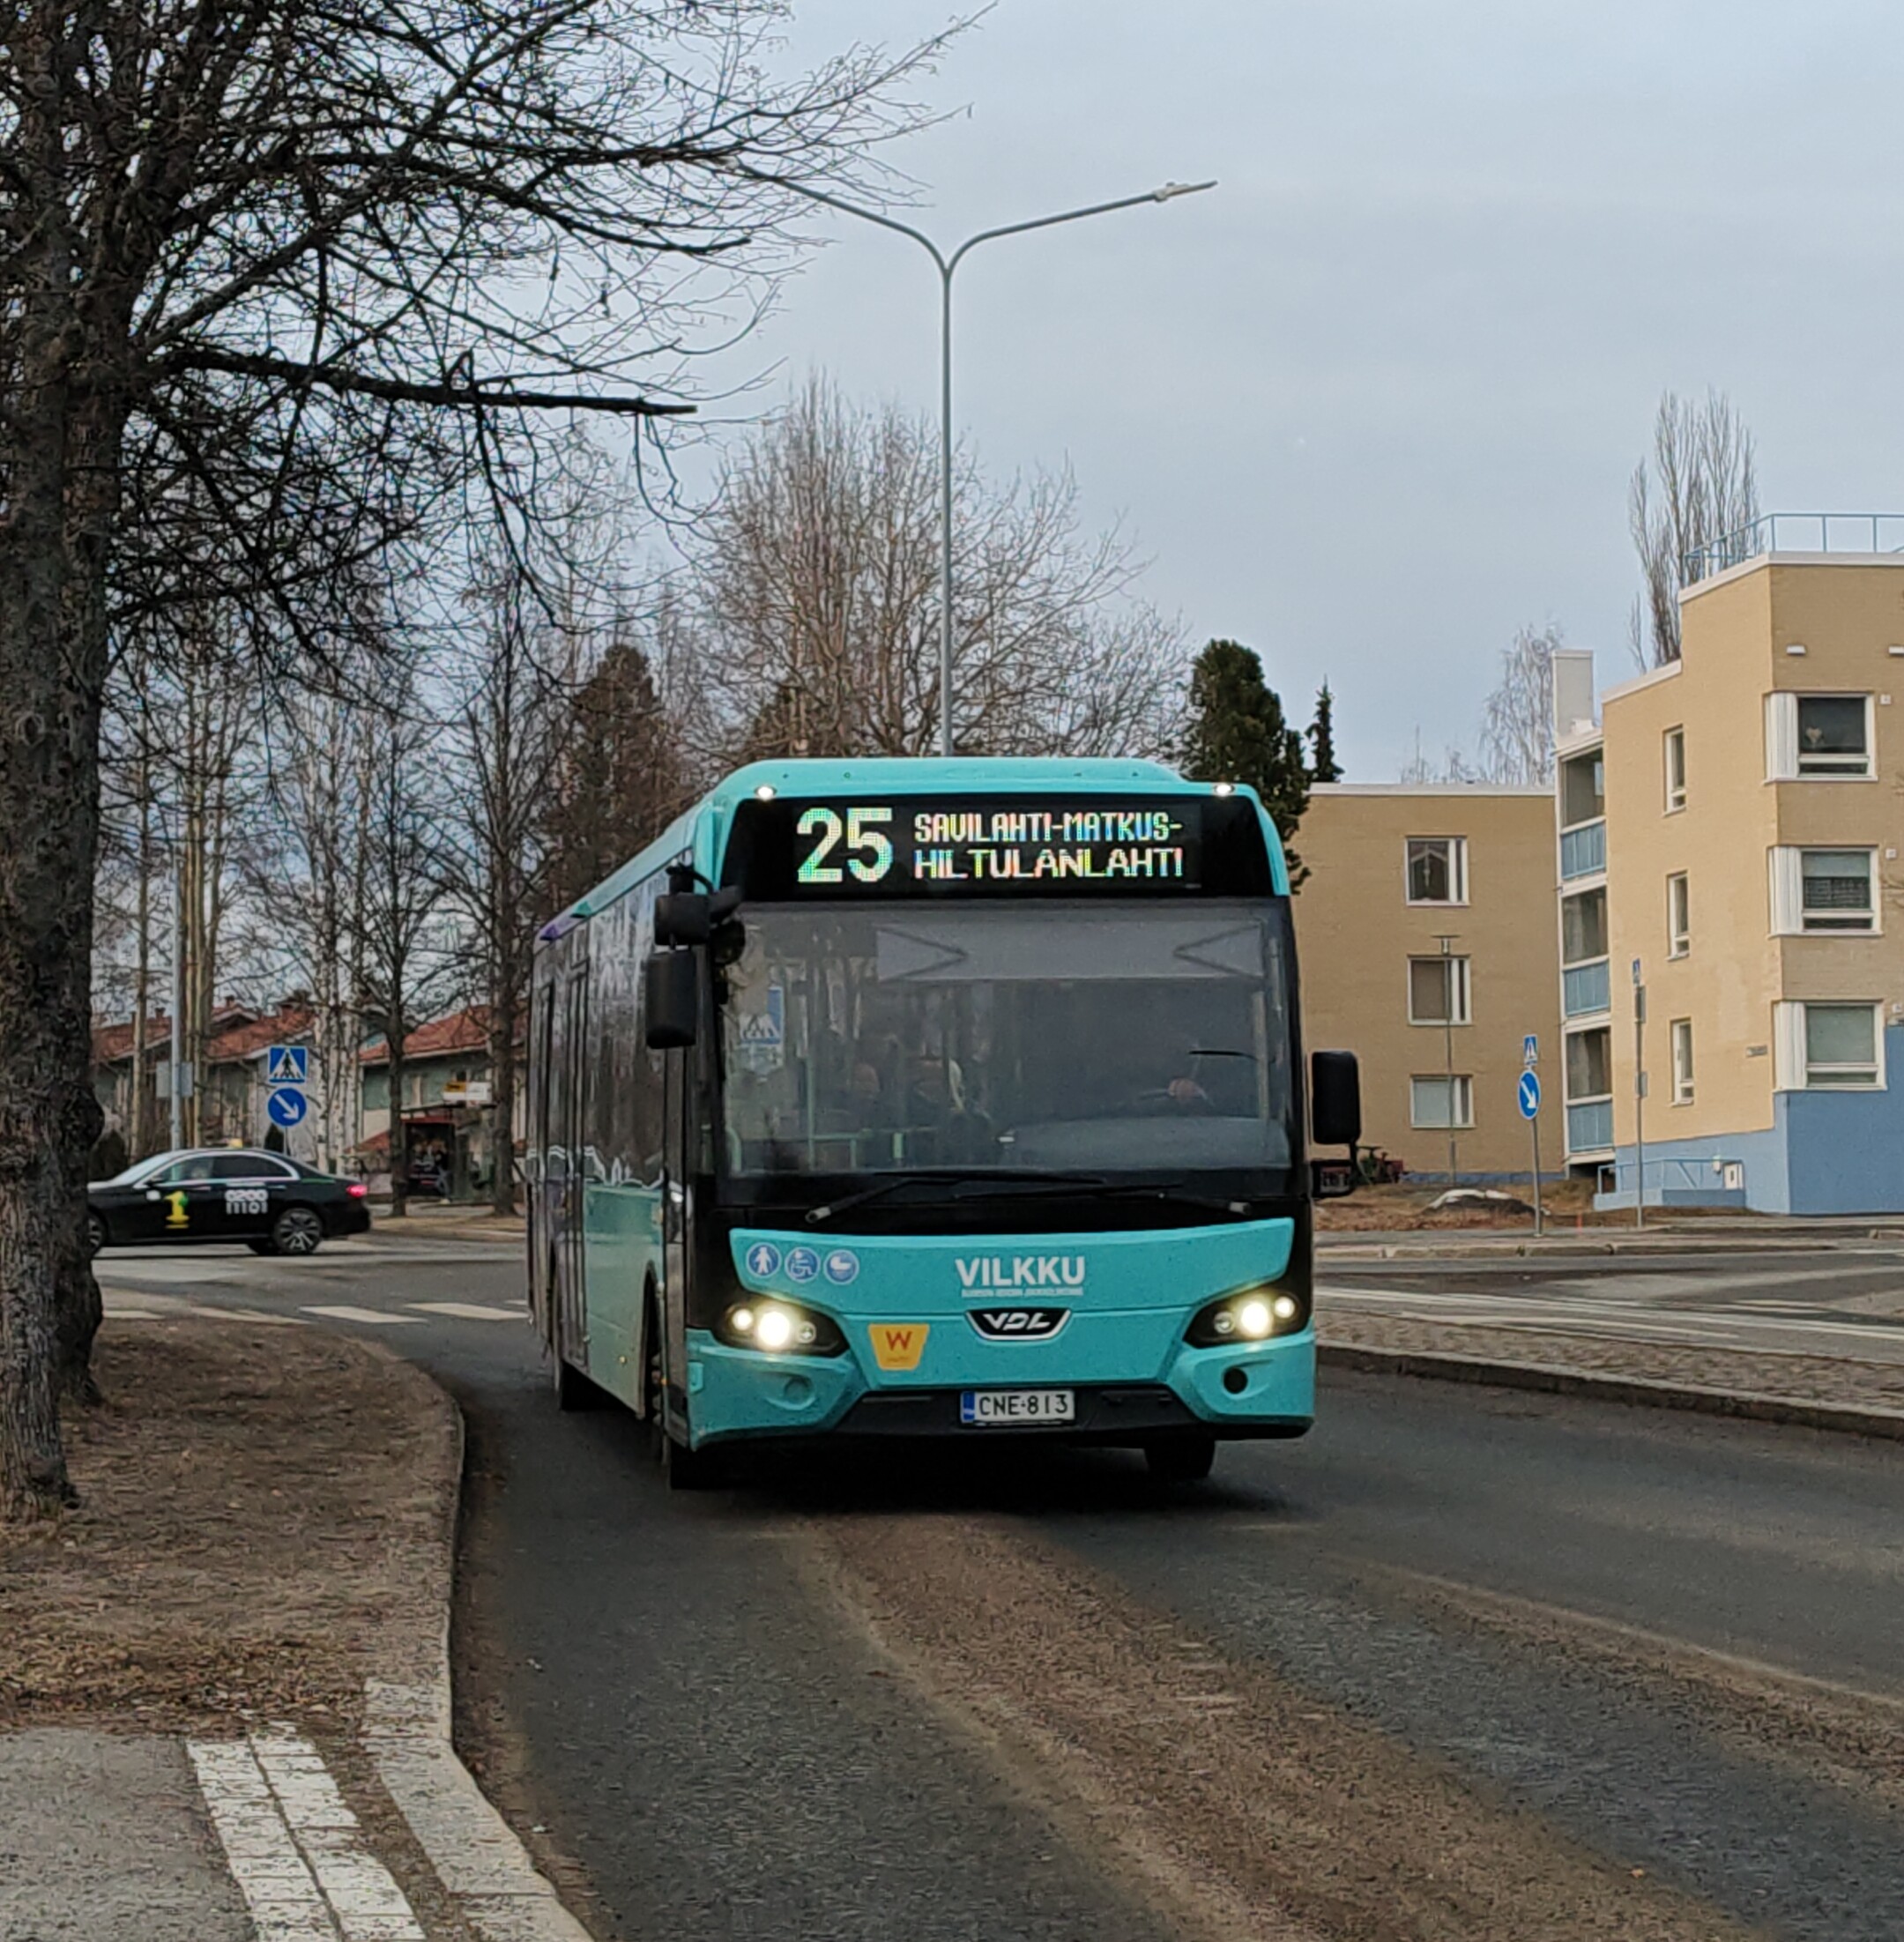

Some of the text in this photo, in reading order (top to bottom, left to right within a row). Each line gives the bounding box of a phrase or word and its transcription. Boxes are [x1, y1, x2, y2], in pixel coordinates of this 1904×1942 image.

[914, 812, 1184, 842] SAVILAHTI-MATKUS-
[797, 807, 893, 882] 25
[914, 847, 1184, 879] HILTULANLAHTI
[955, 1256, 1085, 1286] VILKKU
[982, 1313, 1051, 1330] VDL
[885, 1330, 912, 1351] W
[979, 1395, 1068, 1416] CNE-813
